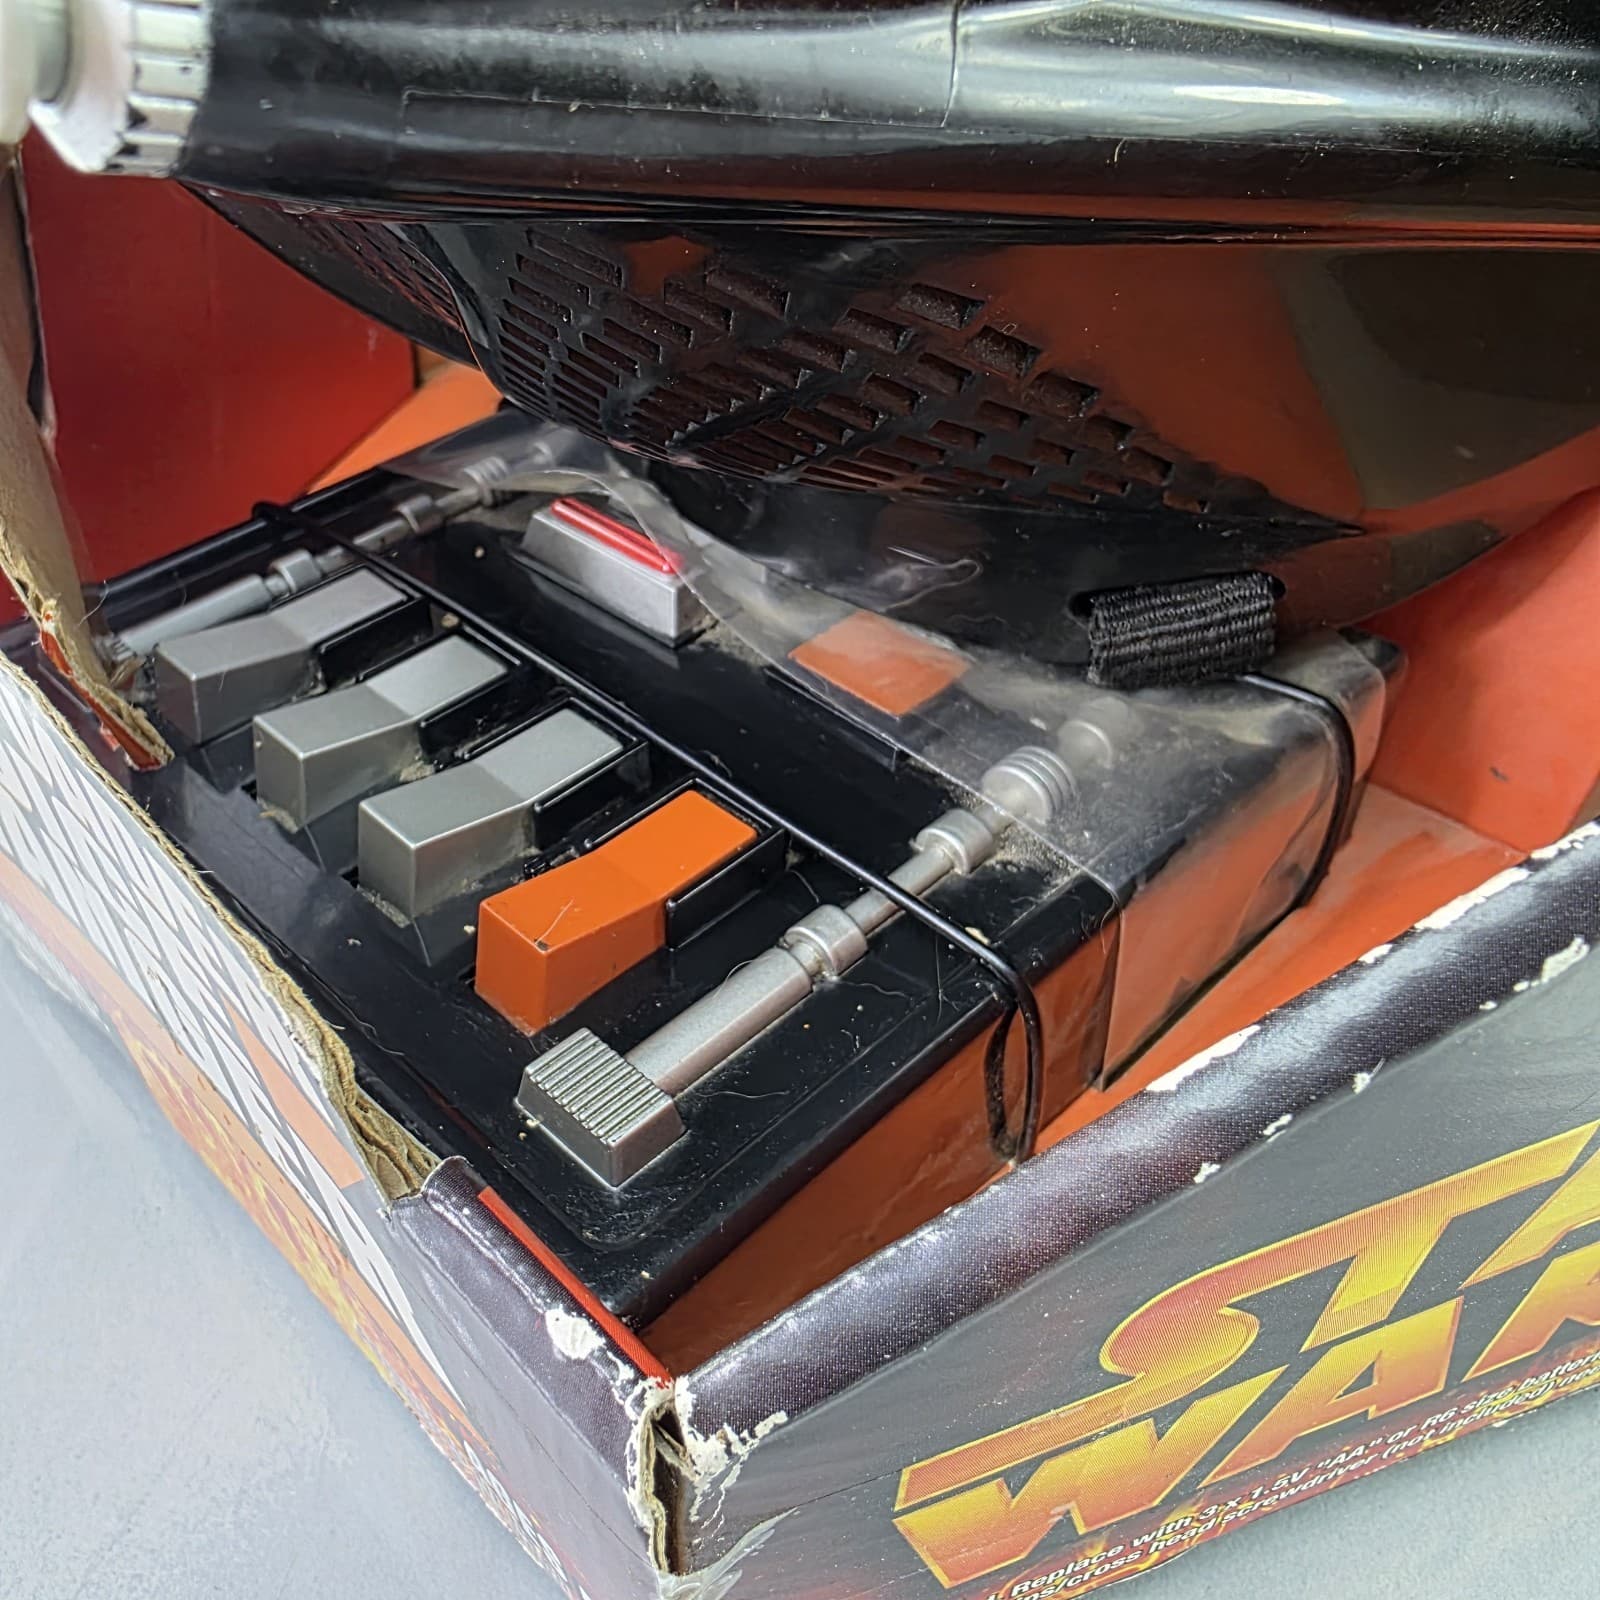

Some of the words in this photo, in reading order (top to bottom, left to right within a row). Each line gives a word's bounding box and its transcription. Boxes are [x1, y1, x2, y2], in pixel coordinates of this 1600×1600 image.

[0, 783, 466, 1411] ANGER
[1011, 1545, 1124, 1597] Replace
[1133, 1516, 1192, 1547] with
[1199, 1505, 1218, 1520] 3
[1224, 1496, 1241, 1509] x
[1251, 1467, 1309, 1498] 1.5V
[1387, 1425, 1417, 1444] or
[1420, 1407, 1458, 1430] R6
[1460, 1385, 1516, 1414] size
[1517, 1349, 1600, 1390] batteri
[1149, 1517, 1217, 1554] head
[1223, 1453, 1378, 1524] screwdriver
[1382, 1429, 1435, 1459] (not
[1438, 1380, 1556, 1434] included)
